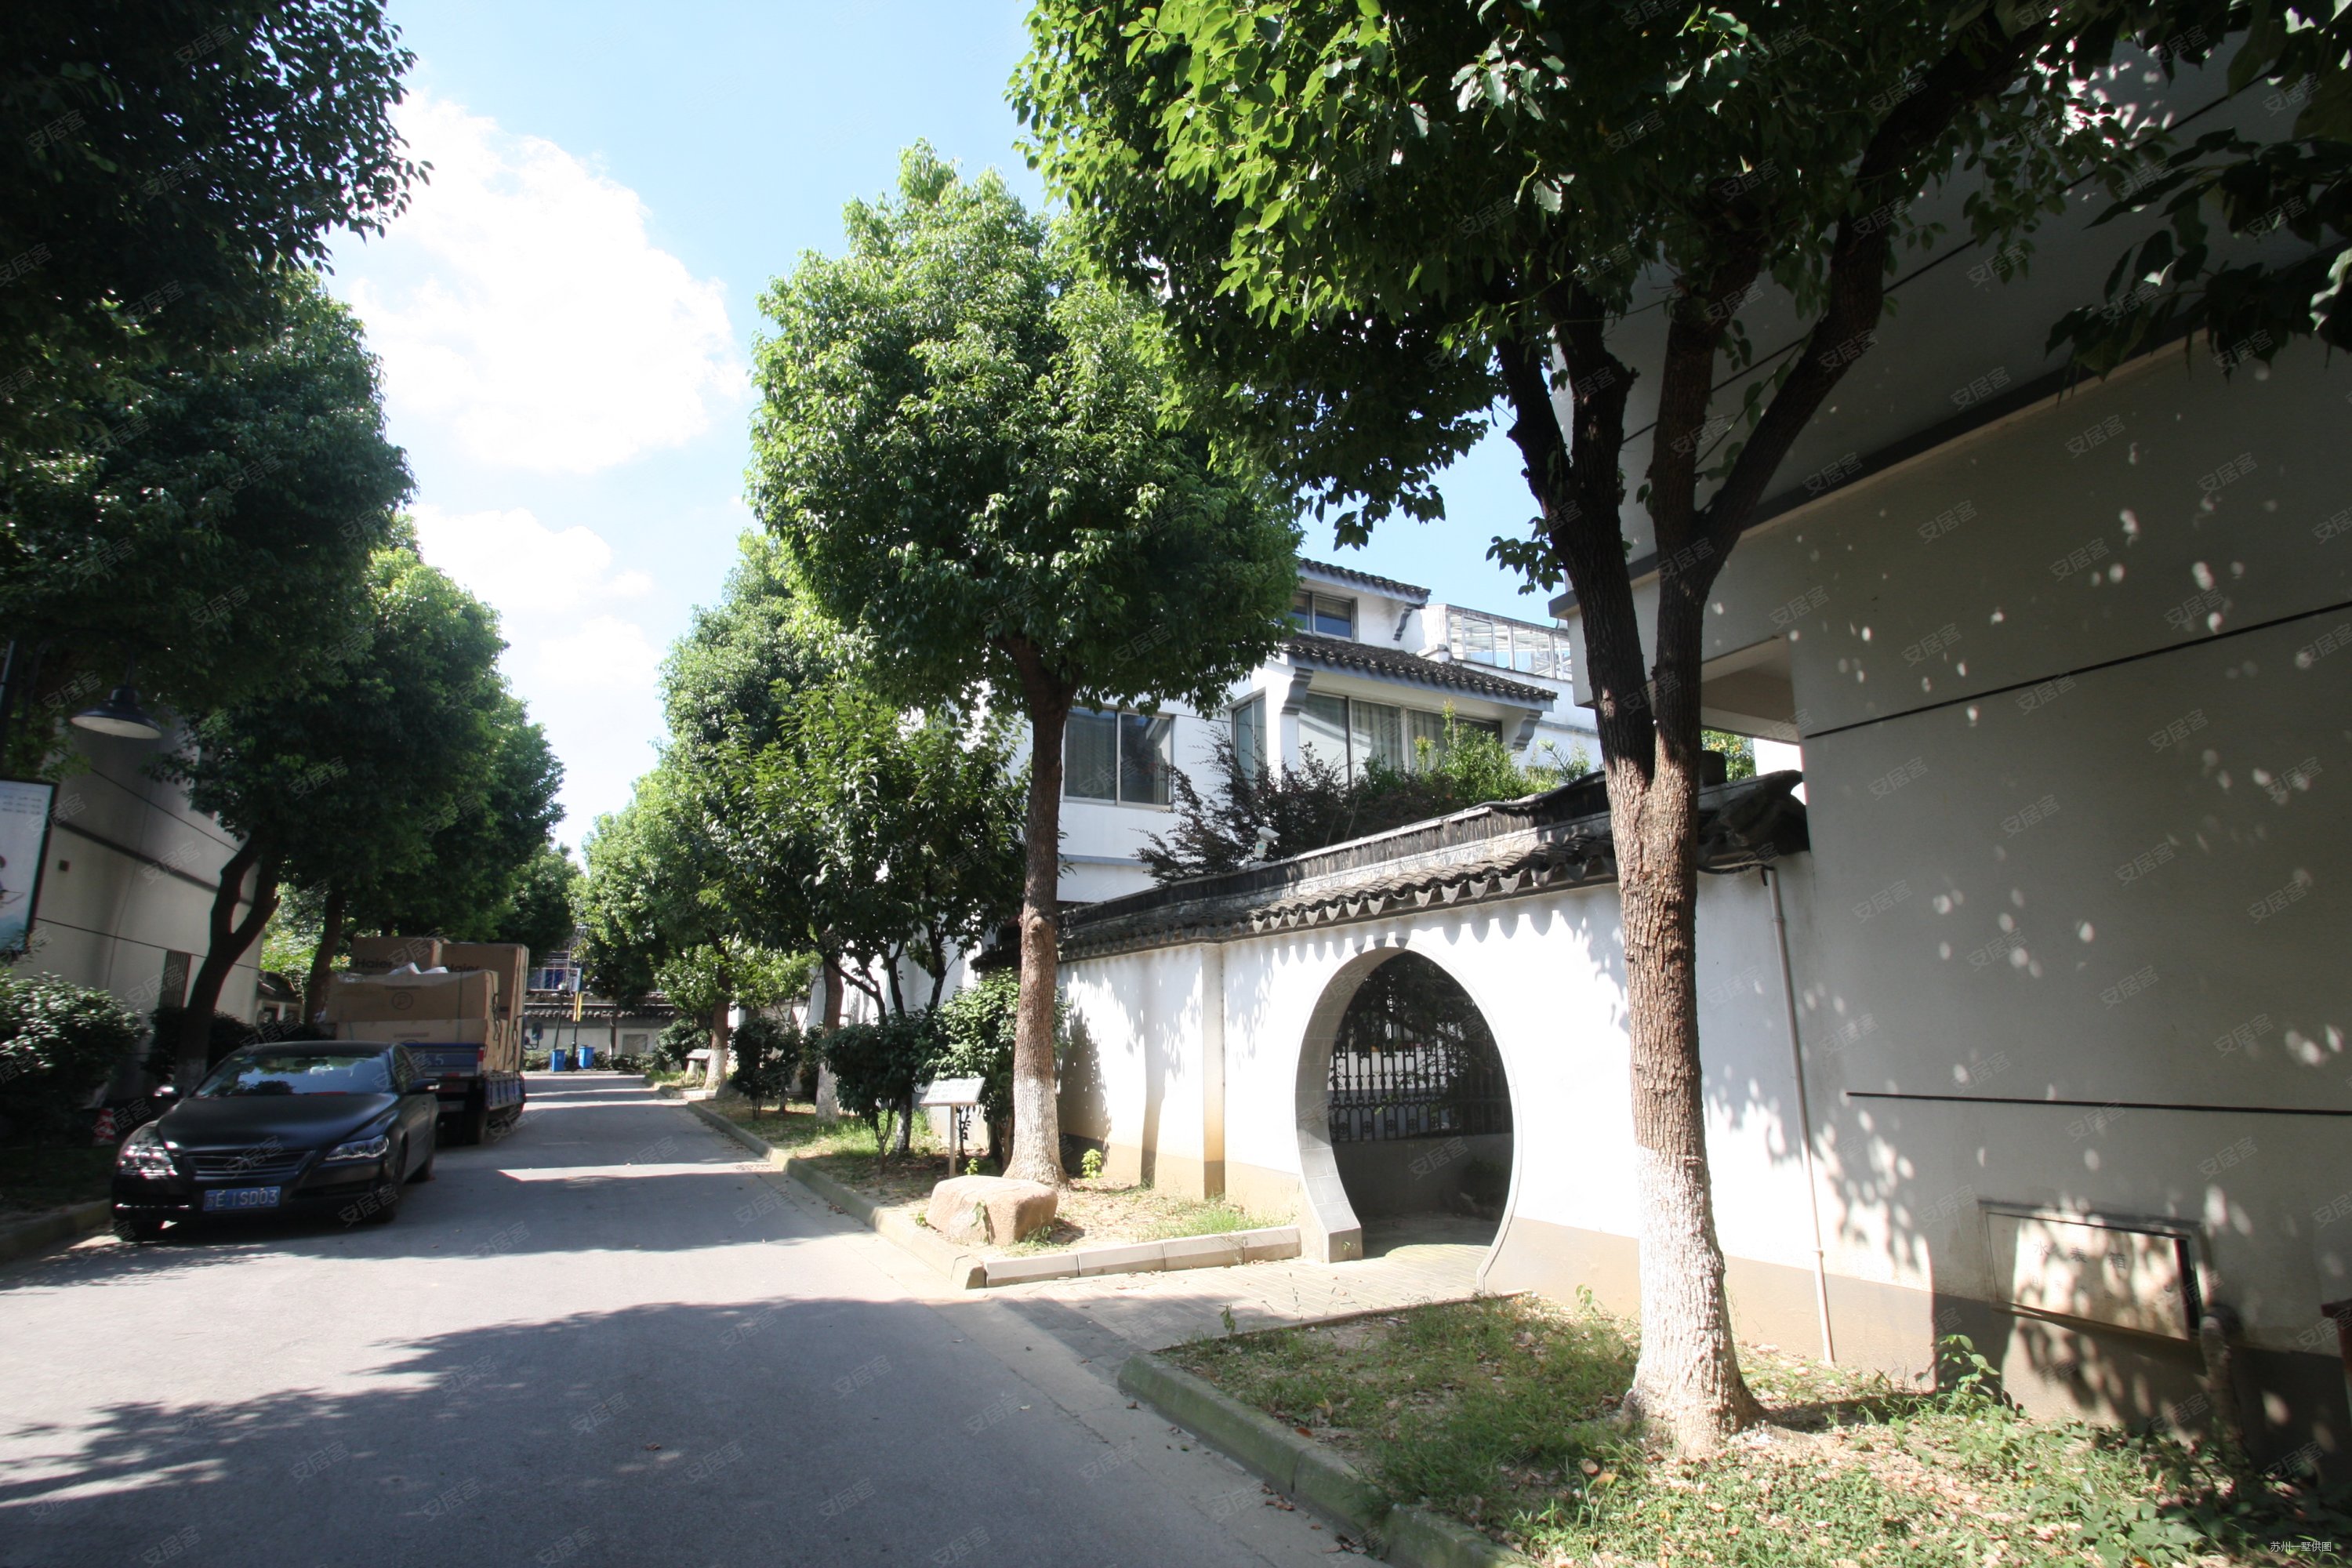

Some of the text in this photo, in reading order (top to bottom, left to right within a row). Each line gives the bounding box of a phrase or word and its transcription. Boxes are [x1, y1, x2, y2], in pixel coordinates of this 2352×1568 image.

[354, 957, 393, 968] Haier
[2033, 1240, 2127, 1270] 水表箱
